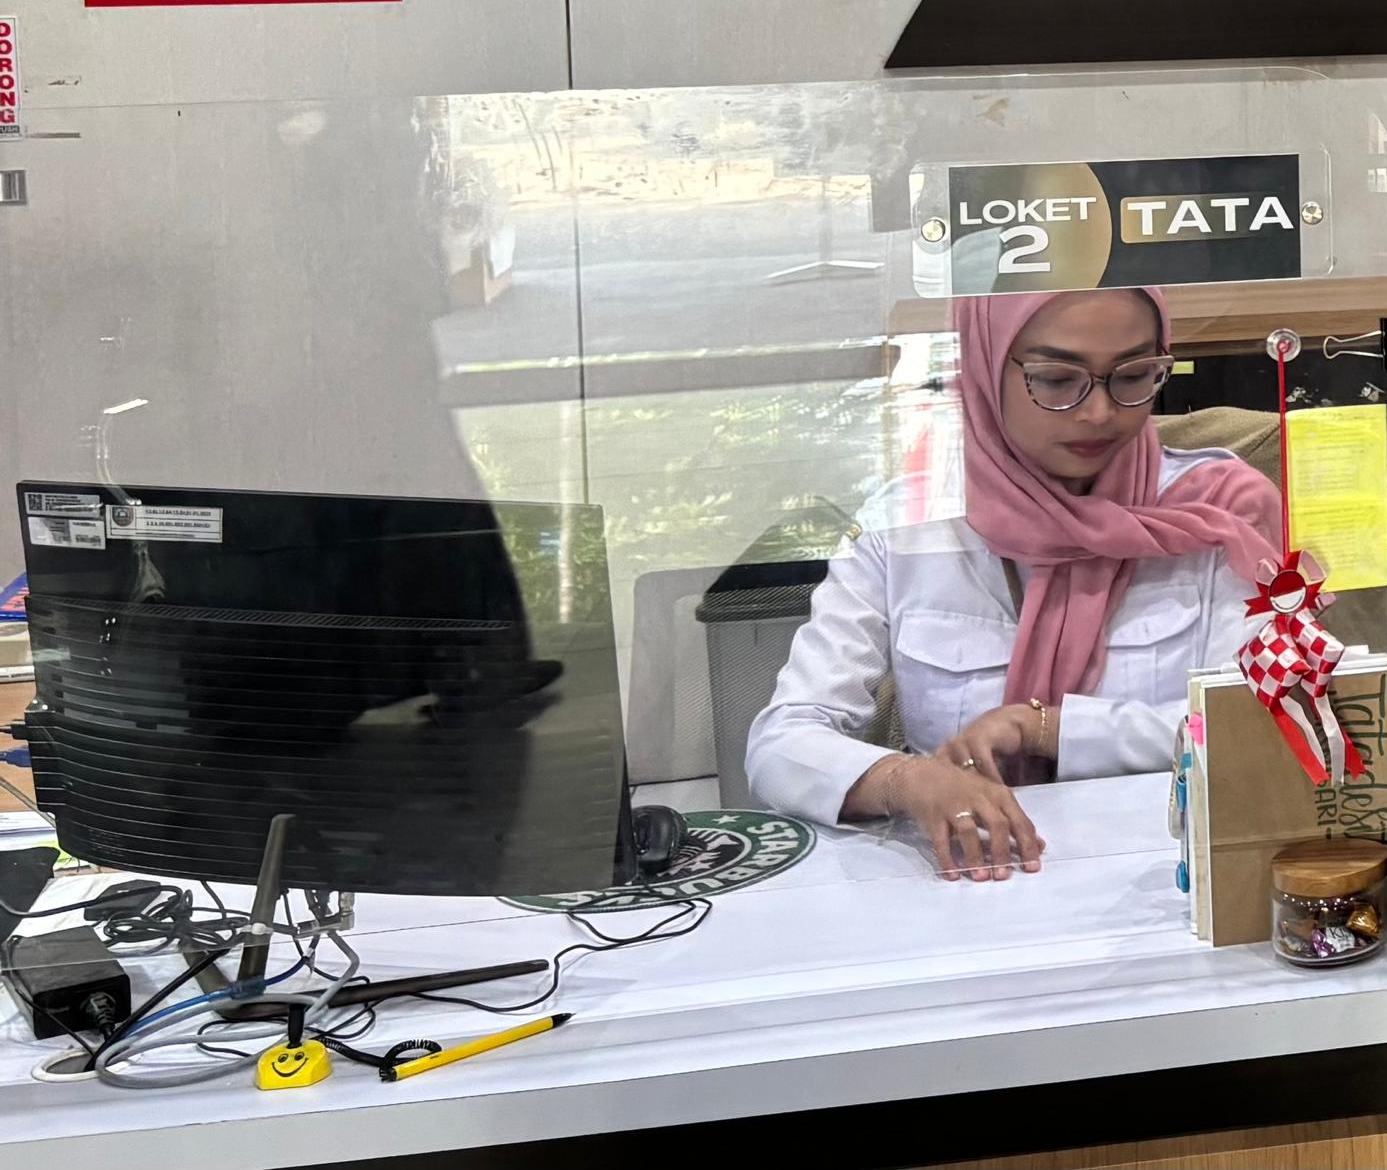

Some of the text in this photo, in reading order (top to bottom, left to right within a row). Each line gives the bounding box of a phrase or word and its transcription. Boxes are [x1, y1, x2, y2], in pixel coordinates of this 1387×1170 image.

[958, 196, 1097, 225] LOKET
[1127, 196, 1294, 236] TATA
[997, 224, 1051, 274] 2
